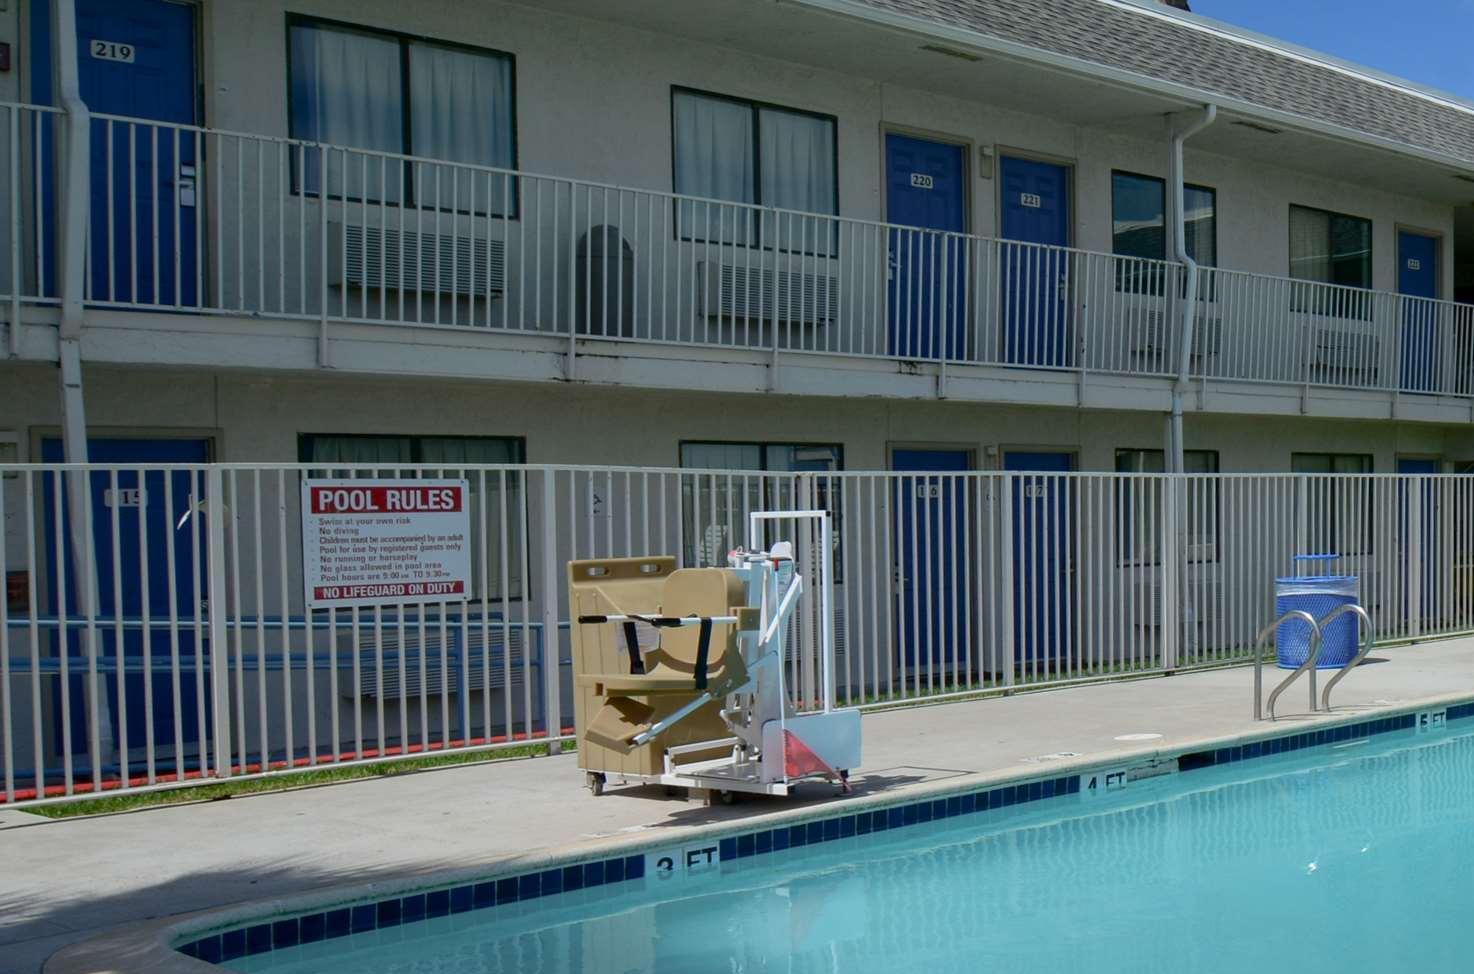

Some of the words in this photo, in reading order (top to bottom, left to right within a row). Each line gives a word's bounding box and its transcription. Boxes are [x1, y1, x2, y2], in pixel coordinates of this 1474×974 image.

[95, 42, 131, 59] 219
[913, 175, 931, 187] 220
[1023, 194, 1039, 206] 221
[318, 489, 379, 511] POOL
[386, 489, 455, 510] RULES
[356, 518, 373, 526] your
[396, 517, 411, 525] risk
[320, 546, 337, 554] Pool
[339, 545, 350, 553] for
[353, 545, 366, 553] use
[368, 545, 377, 554] by
[380, 544, 418, 553] registered
[420, 543, 444, 552] guests
[446, 542, 461, 552] only
[335, 555, 366, 563] running
[380, 553, 417, 562] horseplay
[335, 564, 357, 573] glass
[360, 563, 392, 571] allowed
[405, 561, 422, 570] pool
[320, 574, 339, 582] Pool
[342, 573, 365, 581] hours
[323, 587, 340, 598] NO
[343, 584, 405, 598] LIFEGUARD
[408, 583, 424, 595] ON
[427, 581, 456, 594] DUTY
[1433, 711, 1445, 723] FT
[1106, 771, 1126, 787] FT
[687, 846, 718, 868] FT
